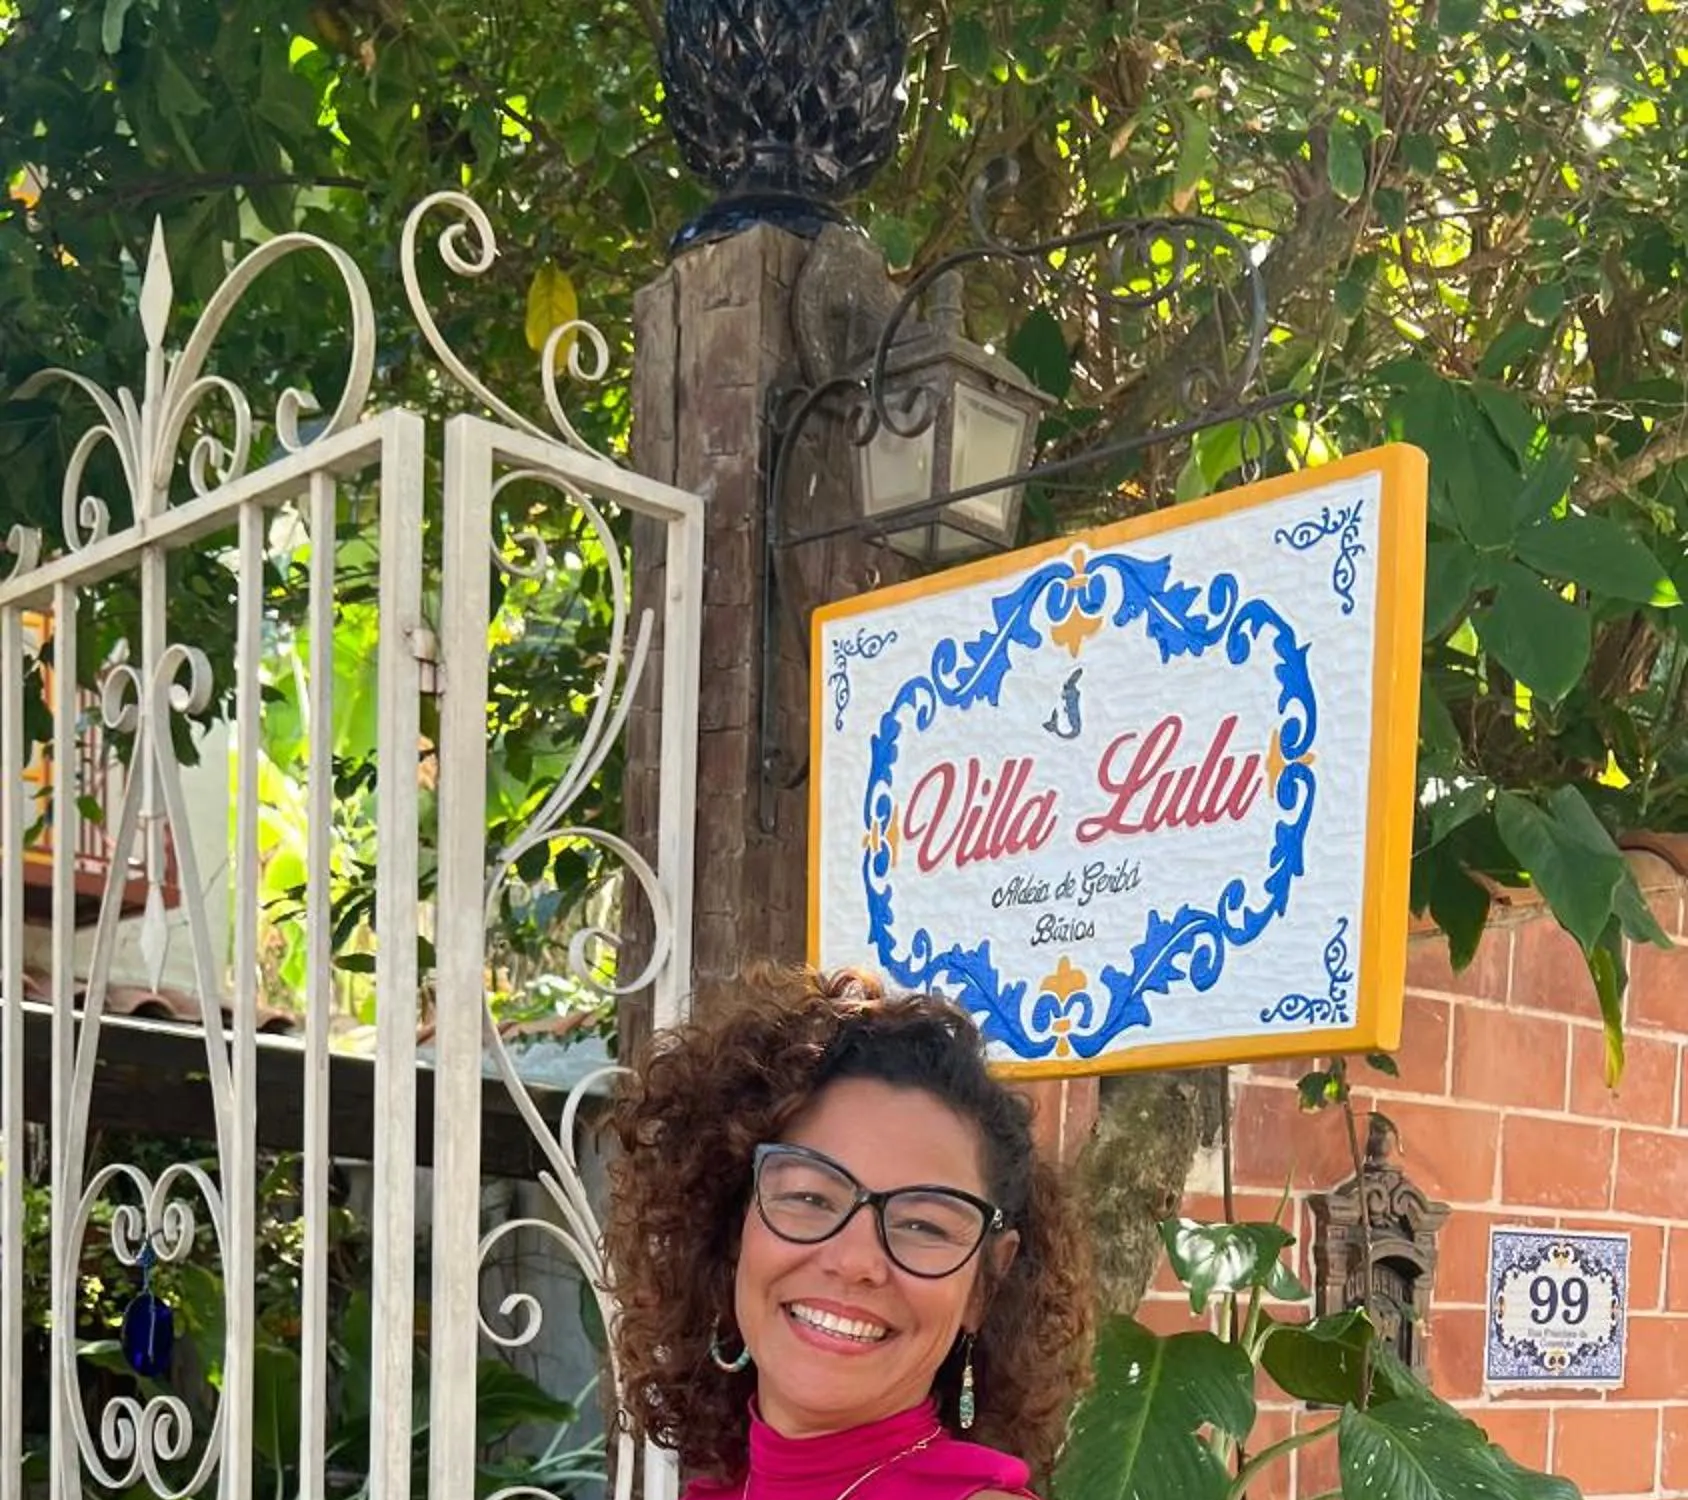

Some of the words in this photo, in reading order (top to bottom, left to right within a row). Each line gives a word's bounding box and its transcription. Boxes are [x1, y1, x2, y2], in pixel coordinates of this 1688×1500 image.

[903, 757, 1058, 873] Villa
[1076, 714, 1263, 844] Lulu
[991, 873, 1051, 909] Aldeia
[1055, 870, 1076, 901] de
[1078, 858, 1142, 907] Geribá
[1529, 1275, 1589, 1325] 99
